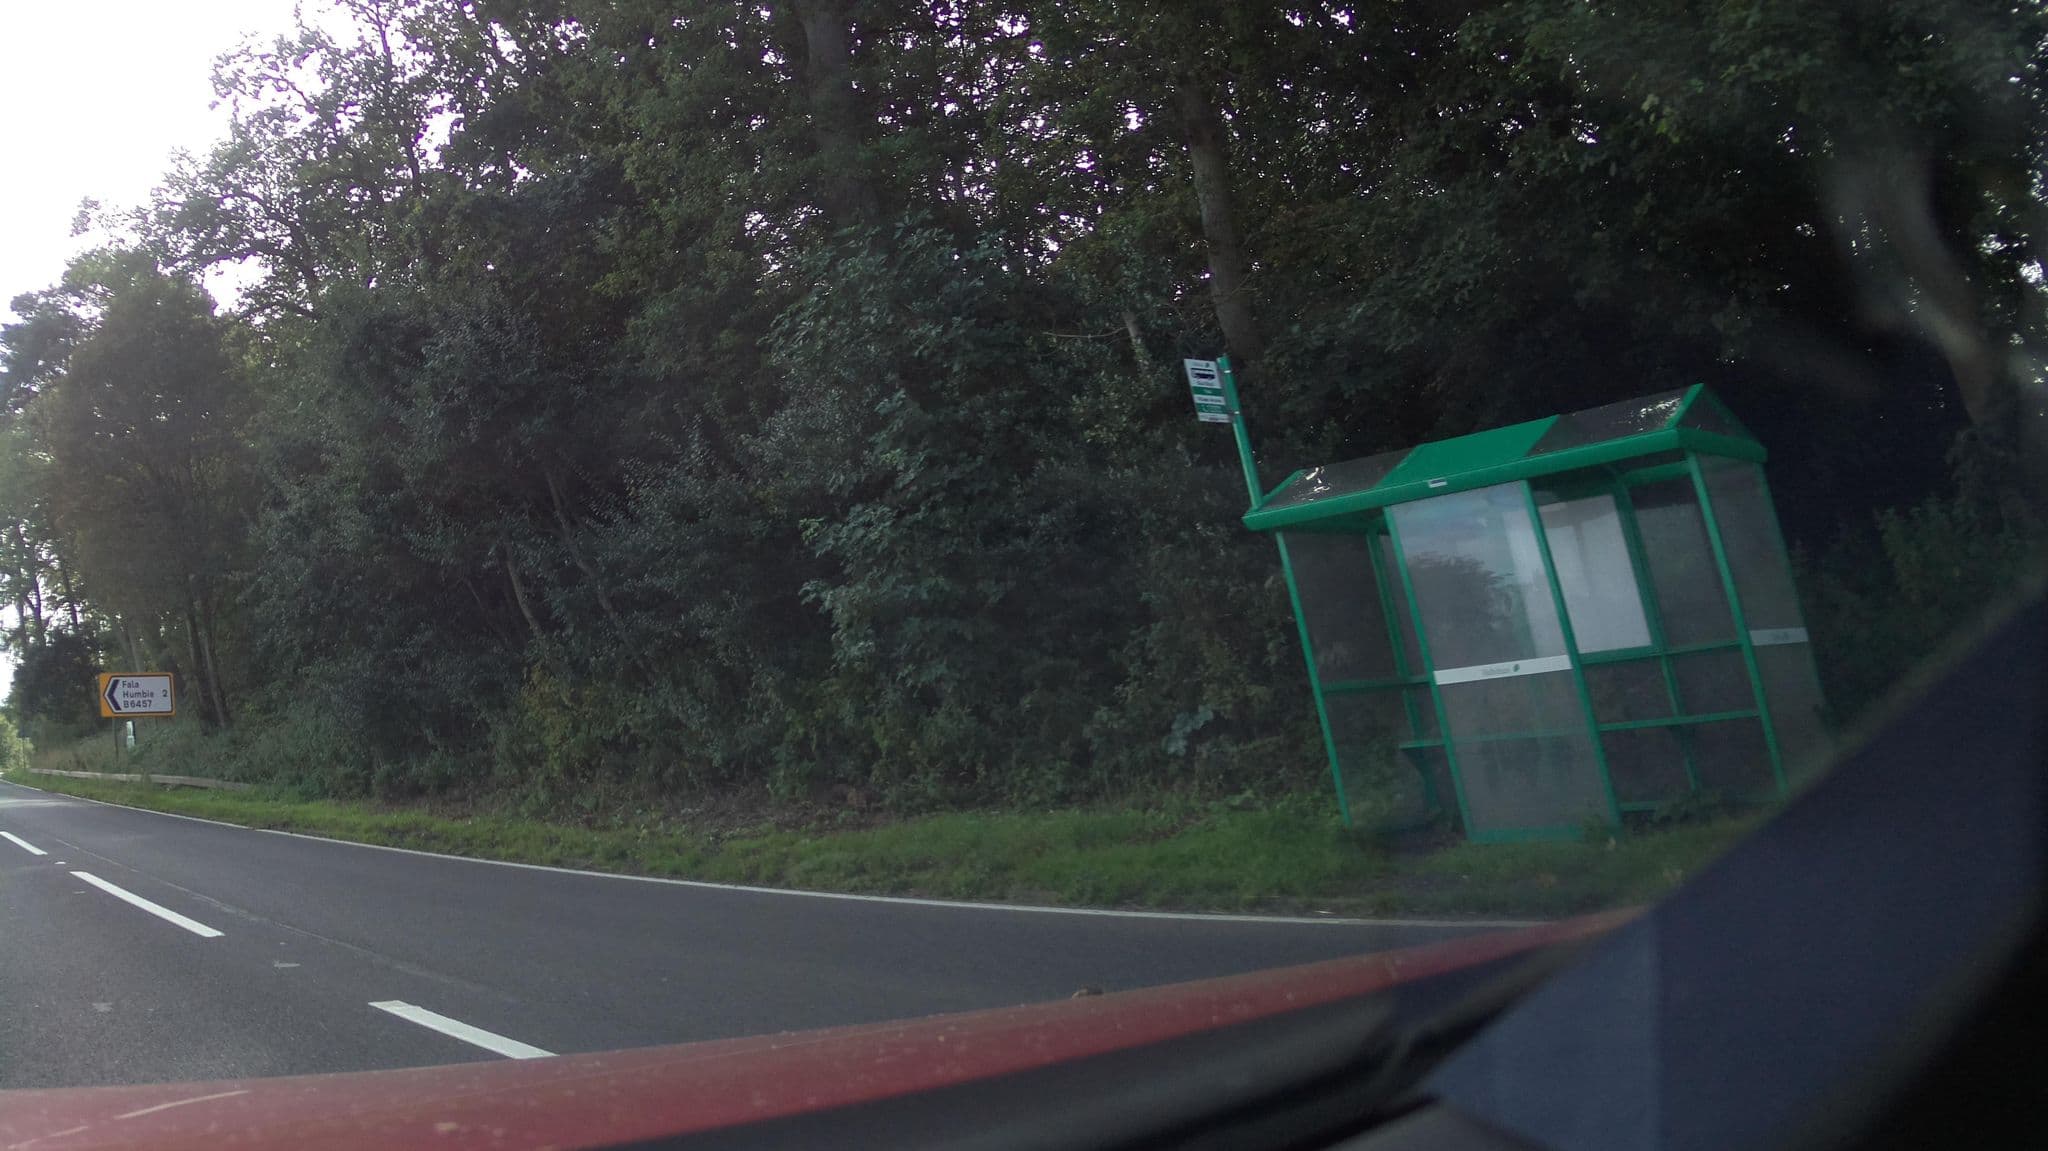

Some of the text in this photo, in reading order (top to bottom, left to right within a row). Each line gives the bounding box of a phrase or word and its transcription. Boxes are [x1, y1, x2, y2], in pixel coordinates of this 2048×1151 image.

[122, 680, 140, 688] Fala
[122, 689, 168, 698] Humbie 2
[123, 700, 152, 708] B6457
